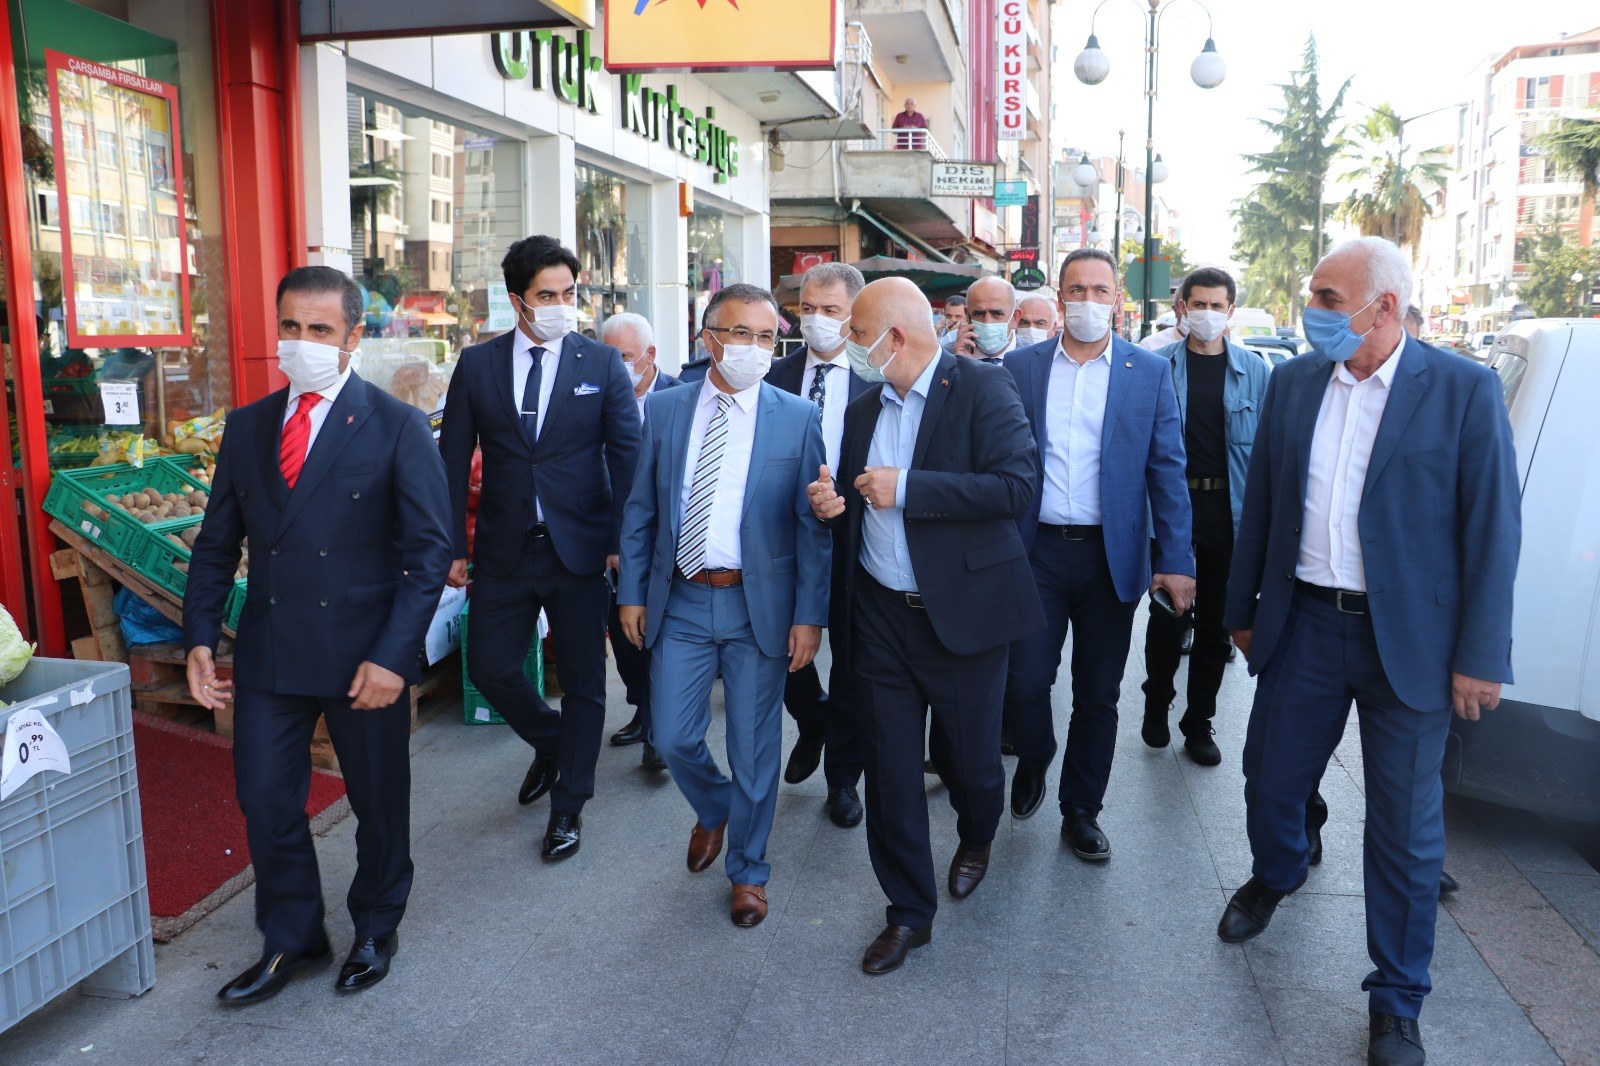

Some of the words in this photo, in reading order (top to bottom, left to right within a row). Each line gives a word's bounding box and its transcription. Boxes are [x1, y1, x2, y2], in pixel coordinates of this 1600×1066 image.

[68, 58, 118, 82] ÇARŞAMBA
[118, 72, 163, 94] FIRSATLARI
[1004, 45, 1021, 128] KURSU
